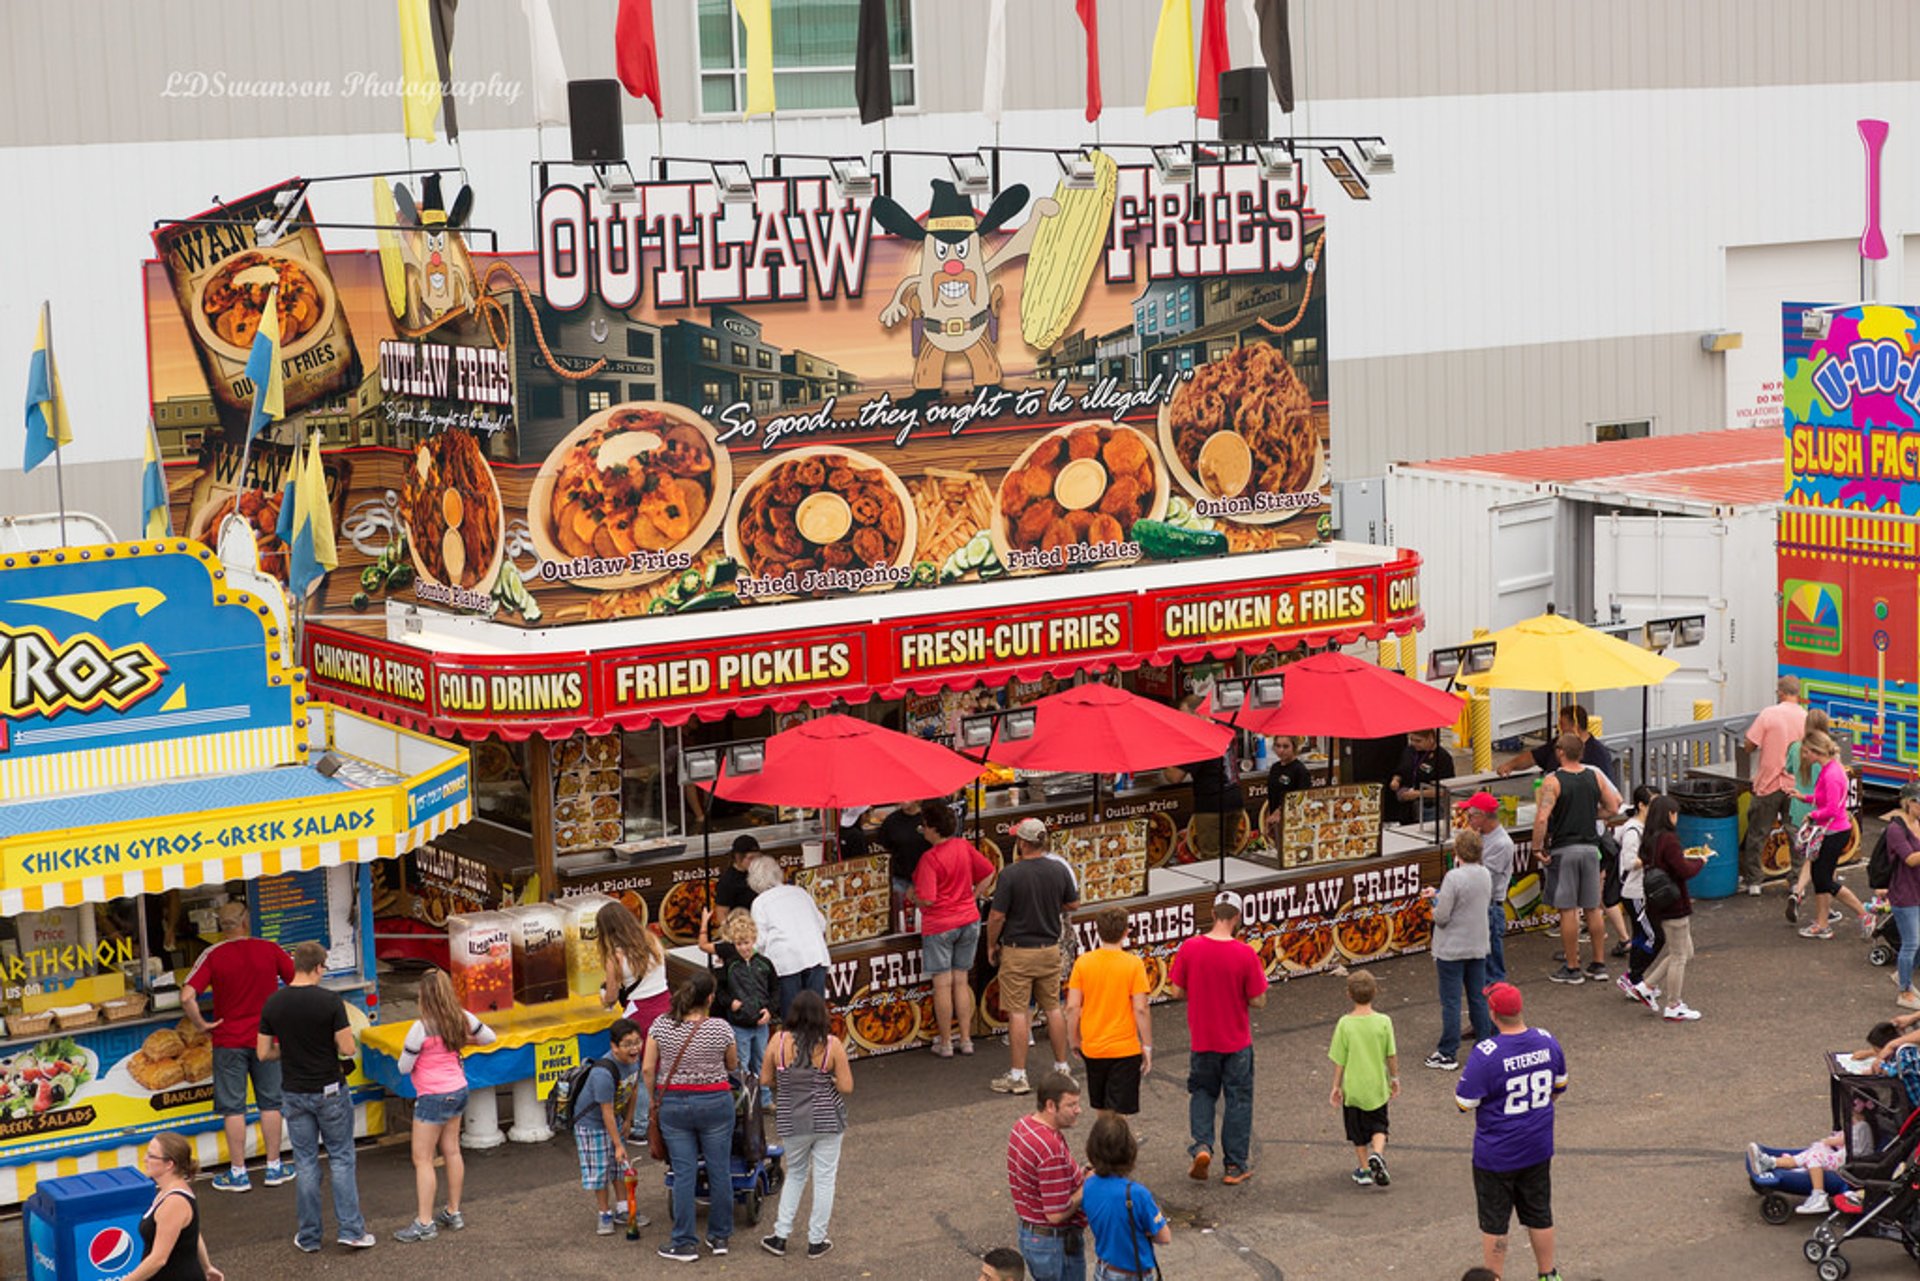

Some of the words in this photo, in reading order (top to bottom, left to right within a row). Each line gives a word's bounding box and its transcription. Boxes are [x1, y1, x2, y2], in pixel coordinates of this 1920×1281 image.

[540, 176, 878, 312] OUTLAW
[1106, 160, 1302, 283] FRIES
[294, 343, 335, 374] FRIES
[380, 340, 449, 399] OUTLAW
[456, 346, 510, 405] FRIES
[927, 386, 1012, 432] ought
[1015, 388, 1046, 414] to
[1048, 382, 1076, 412] be
[1757, 395, 1769, 404] DO
[1792, 427, 1865, 477] SLUSH
[1196, 497, 1250, 516] Onion
[1252, 489, 1320, 511] Straws
[541, 556, 624, 581] Outlaw
[630, 549, 691, 573] Fries
[1007, 547, 1062, 569] Fried
[1067, 540, 1140, 565] Pickles
[736, 573, 797, 597] Fried
[803, 561, 912, 592] Jalapeños
[1165, 594, 1272, 639] CHICKEN
[1276, 592, 1296, 626] &
[1300, 584, 1366, 624] FRIES
[902, 621, 1044, 670] FRESH-CUT
[1049, 612, 1121, 653] FRIES
[314, 642, 371, 689] CHICKEN
[373, 657, 384, 692] &
[385, 660, 426, 702] FRIES
[438, 671, 486, 711] COLD
[491, 671, 583, 711] DRINKS
[616, 658, 711, 703] FRIED
[718, 642, 850, 691] PICKLES
[1057, 811, 1087, 825] Fries
[1106, 804, 1147, 819] Outlaw
[1149, 798, 1179, 812] Fries
[21, 842, 120, 875] CHICKEN
[293, 808, 375, 839] SALADS
[562, 882, 599, 898] Fried
[602, 875, 652, 892] Pickles
[1242, 877, 1344, 926] OUTLAW
[1353, 863, 1421, 906] FRIES
[1122, 903, 1194, 948] FRIES
[6, 986, 21, 999] us
[25, 983, 40, 996] on
[542, 1056, 572, 1070] PRICE
[1502, 1048, 1552, 1072] PETERSON
[1504, 1069, 1553, 1115] 28
[38, 1107, 93, 1129] SALADS
